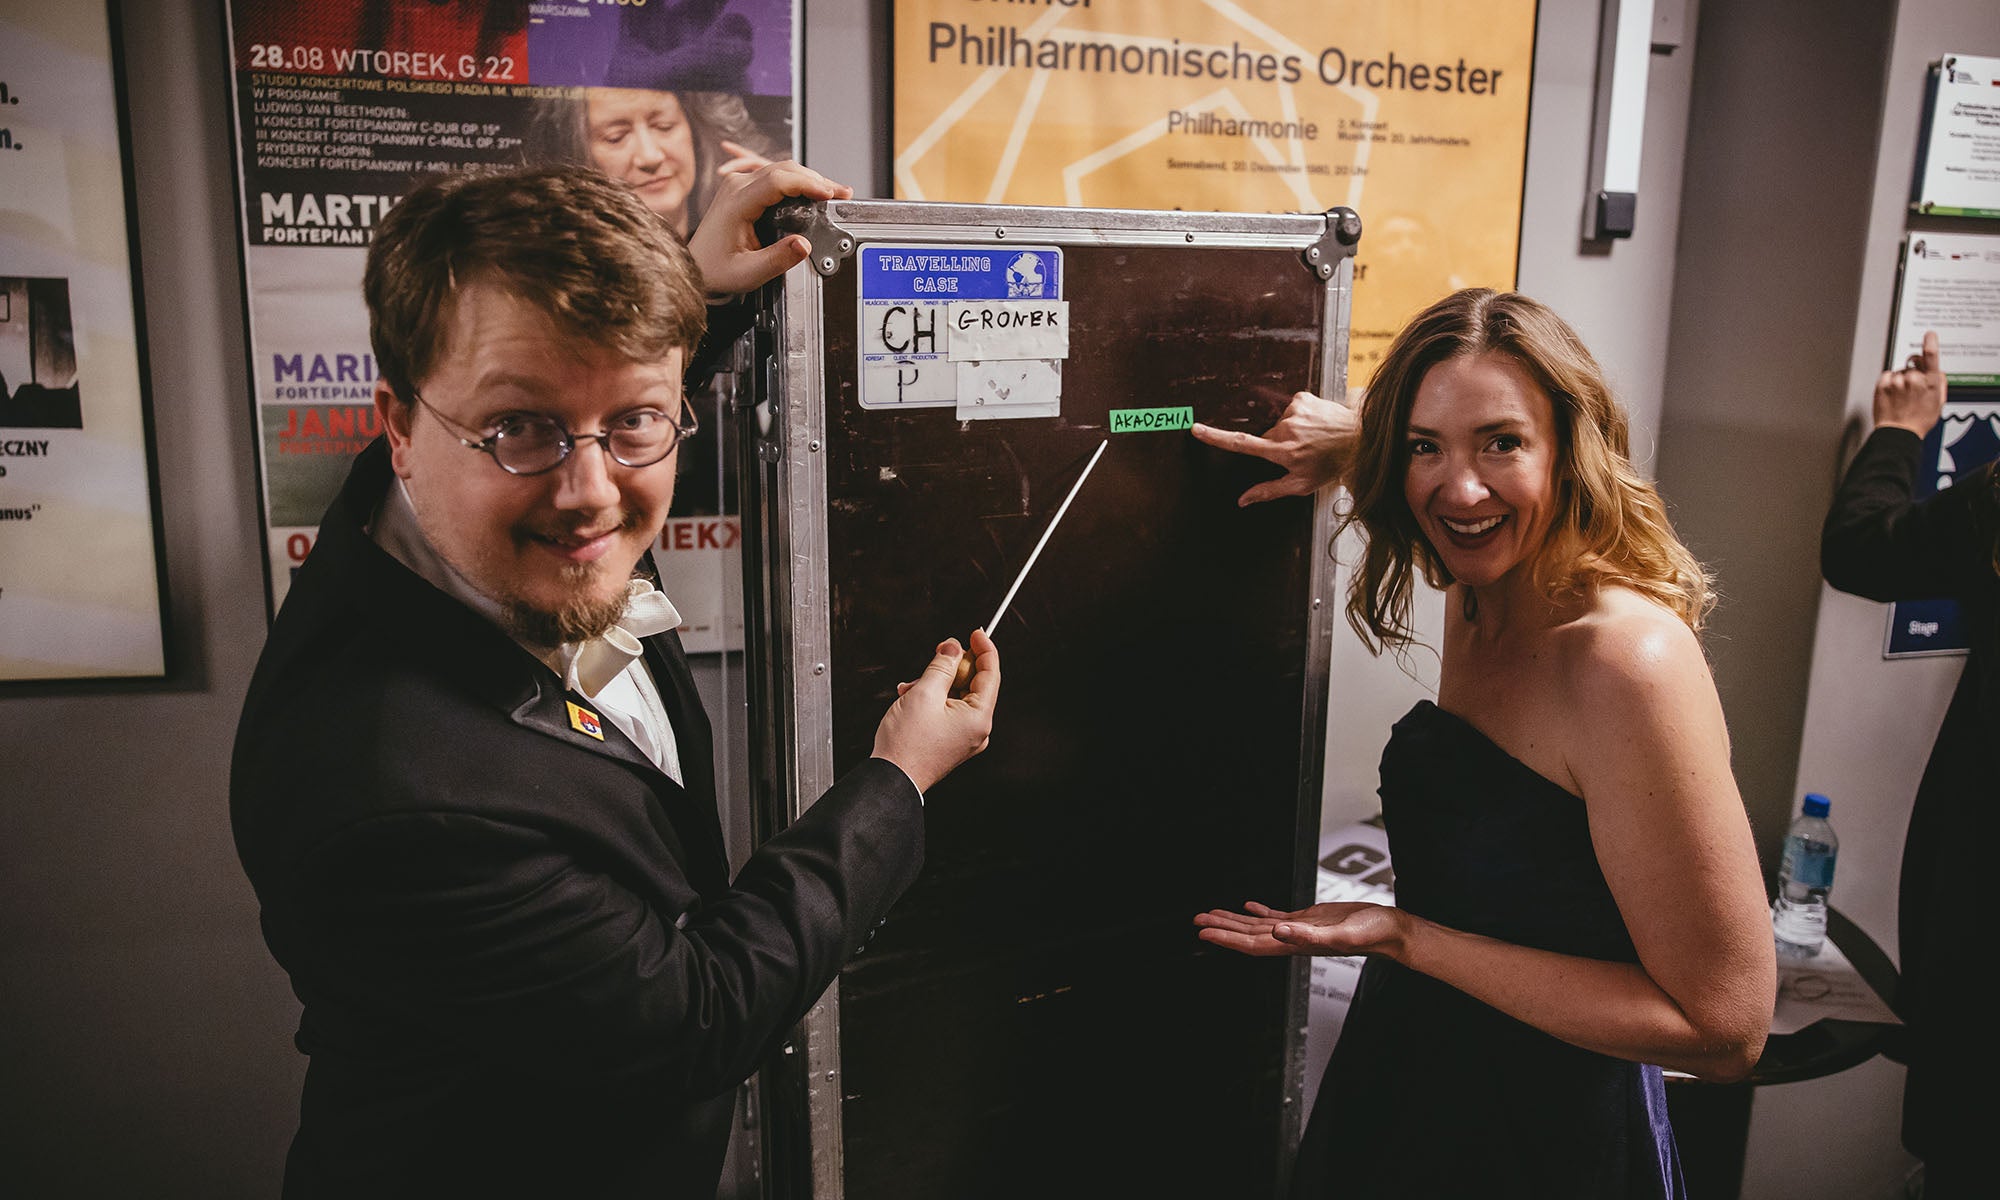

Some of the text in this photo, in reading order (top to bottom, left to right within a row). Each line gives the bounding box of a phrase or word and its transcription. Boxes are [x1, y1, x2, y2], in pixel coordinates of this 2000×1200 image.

[250, 44, 515, 80] 28.08 WTOREK, G.22
[928, 22, 1503, 95] Philharmonisches Orchester
[252, 73, 298, 87] STUDIO
[300, 77, 384, 92] KONCERTOWE
[387, 80, 453, 95] POLSKIEGO
[455, 84, 490, 96] RADIA
[253, 87, 264, 98] W
[254, 101, 303, 114] LUDWIG
[305, 103, 331, 116] VAN
[262, 116, 320, 129] KONCERT
[324, 118, 418, 132] FORTEPIANOWY
[420, 121, 460, 134] C-DUR
[1168, 110, 1318, 141] Philharmonie
[256, 129, 267, 141] III
[270, 130, 330, 142] KONCERT
[332, 132, 426, 147] FORTEPIANOWY
[427, 134, 475, 149] C-MOLL
[257, 142, 321, 156] FRYDERYK
[258, 157, 318, 169] KONCERT
[320, 159, 412, 172] FORTEPIANOWY
[263, 227, 364, 244] FORTEPIAN
[879, 255, 990, 272] TRAVELLING
[913, 277, 959, 293] CASE
[958, 309, 1058, 330] GRONEK
[882, 306, 935, 353] CH
[273, 353, 380, 383] MARI
[276, 386, 372, 400] FORTEPIAN
[1114, 409, 1190, 431] AKADEMIA
